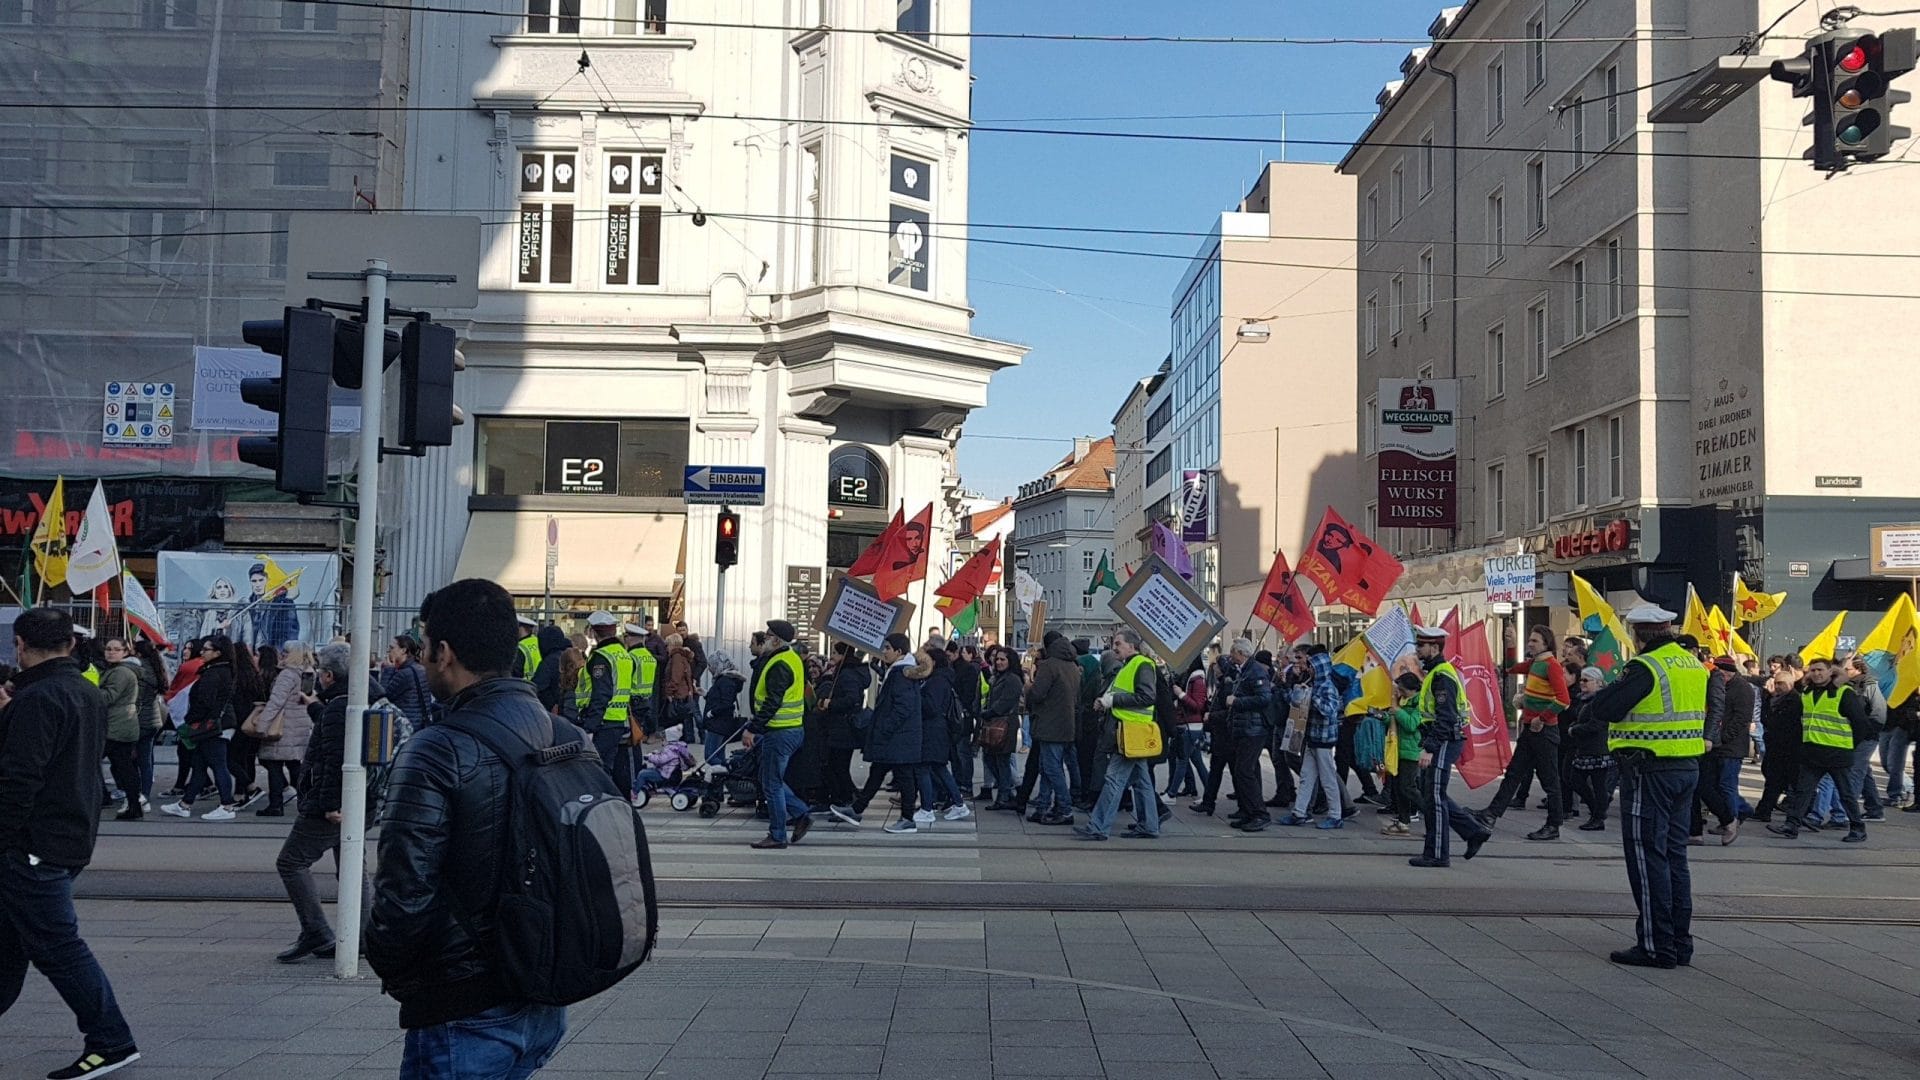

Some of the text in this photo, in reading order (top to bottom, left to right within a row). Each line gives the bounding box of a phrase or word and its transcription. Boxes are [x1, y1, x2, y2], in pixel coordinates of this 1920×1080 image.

[521, 212, 532, 274] PERÜCKEN
[530, 212, 541, 257] PFISTER
[608, 214, 619, 276] PERÜCKEN
[618, 214, 628, 259] PFISTER
[200, 368, 273, 379] GUTER NAME
[1714, 393, 1735, 408] HAUS
[1384, 412, 1449, 423] WEGSCHAIDER
[1699, 408, 1752, 431] DREI KRONEN
[1695, 426, 1757, 456] FREMDEN
[562, 458, 603, 485] E2
[709, 473, 756, 484] EINBAHN
[1381, 468, 1453, 482] FLEISCH
[1699, 455, 1752, 481] ZIMMER
[840, 476, 868, 498] E2
[1387, 486, 1447, 500] WURST
[1184, 474, 1206, 523] OUTLET
[1391, 505, 1444, 518] IMBISS
[1486, 572, 1535, 586] Viele Panzer
[1486, 586, 1512, 602] Wenig
